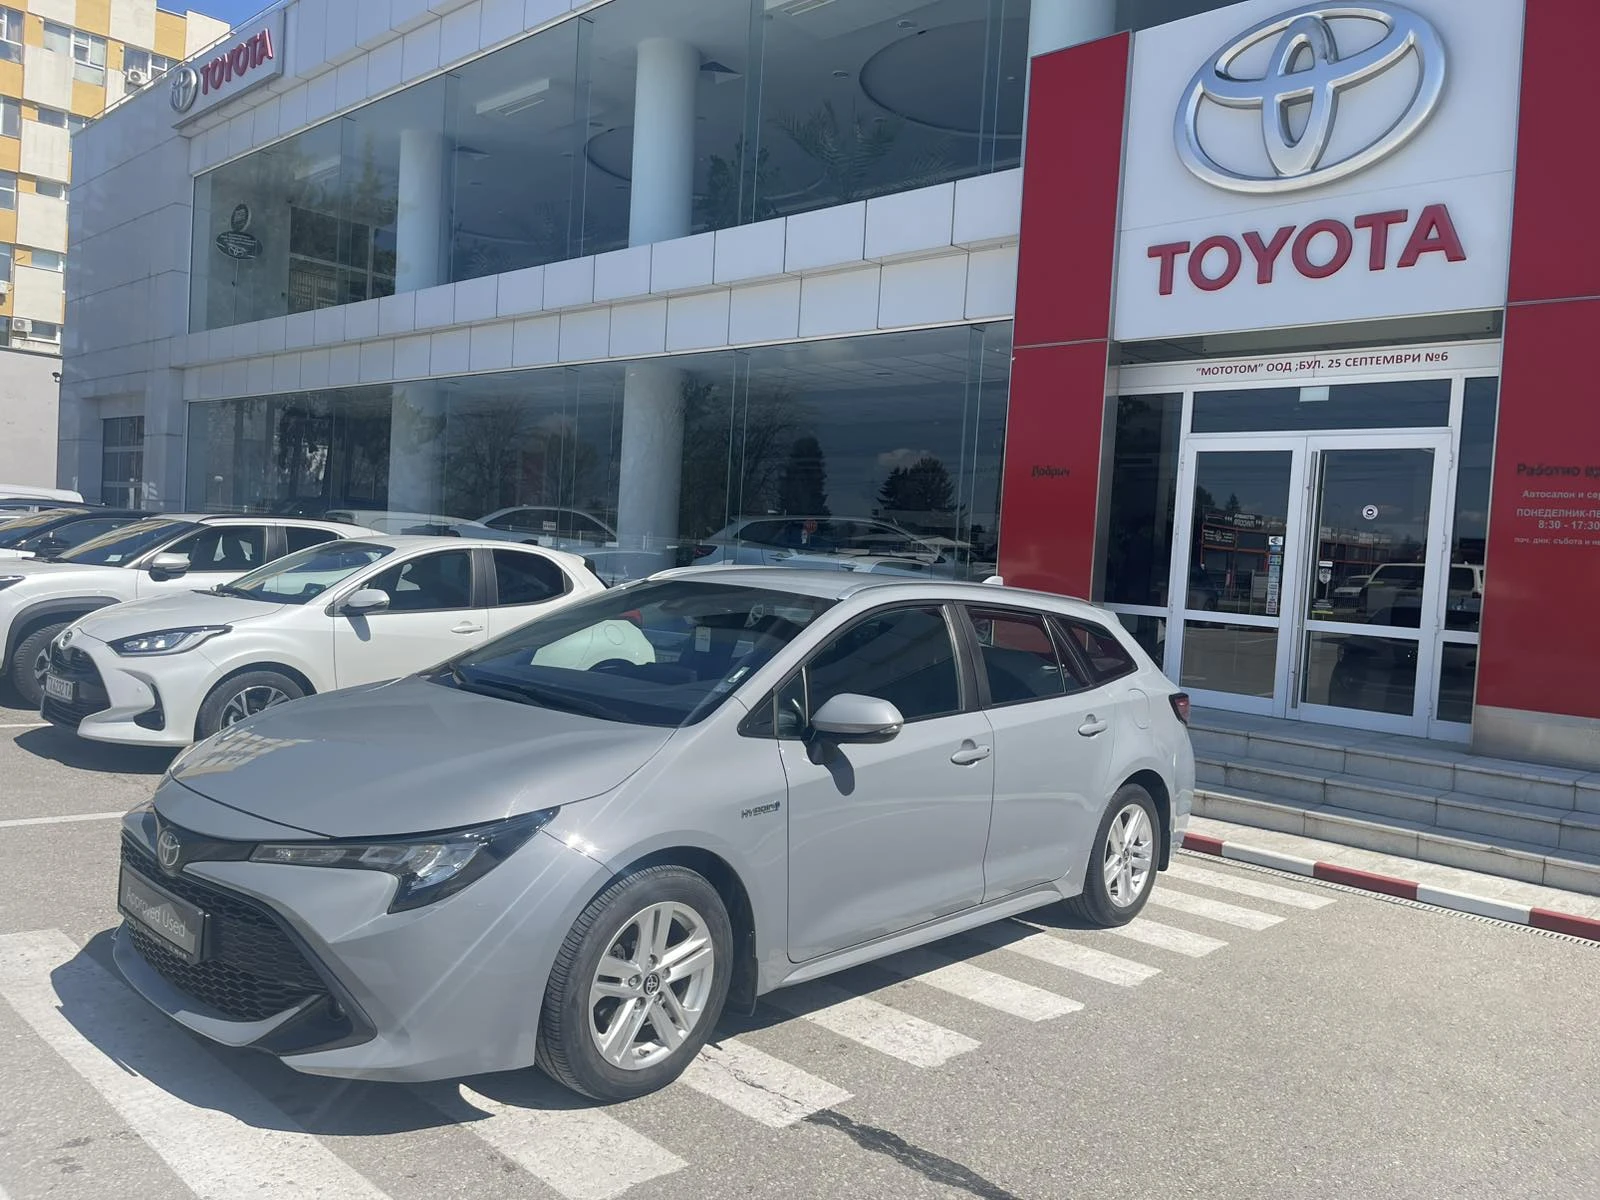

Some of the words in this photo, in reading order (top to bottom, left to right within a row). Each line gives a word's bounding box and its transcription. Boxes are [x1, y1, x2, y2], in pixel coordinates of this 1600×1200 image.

[200, 28, 273, 95] TOYOTA
[1147, 203, 1467, 296] TOYOTA
[1266, 362, 1292, 373] ООД
[1327, 358, 1341, 369] 25
[1344, 353, 1421, 368] СЕПТЕМВРИ
[1424, 351, 1449, 363] №6
[1522, 490, 1575, 499] Автосалон
[1578, 491, 1584, 499] и
[1538, 519, 1561, 529] 8:30
[1571, 520, 1600, 530] 17:30
[162, 911, 186, 938] Used
